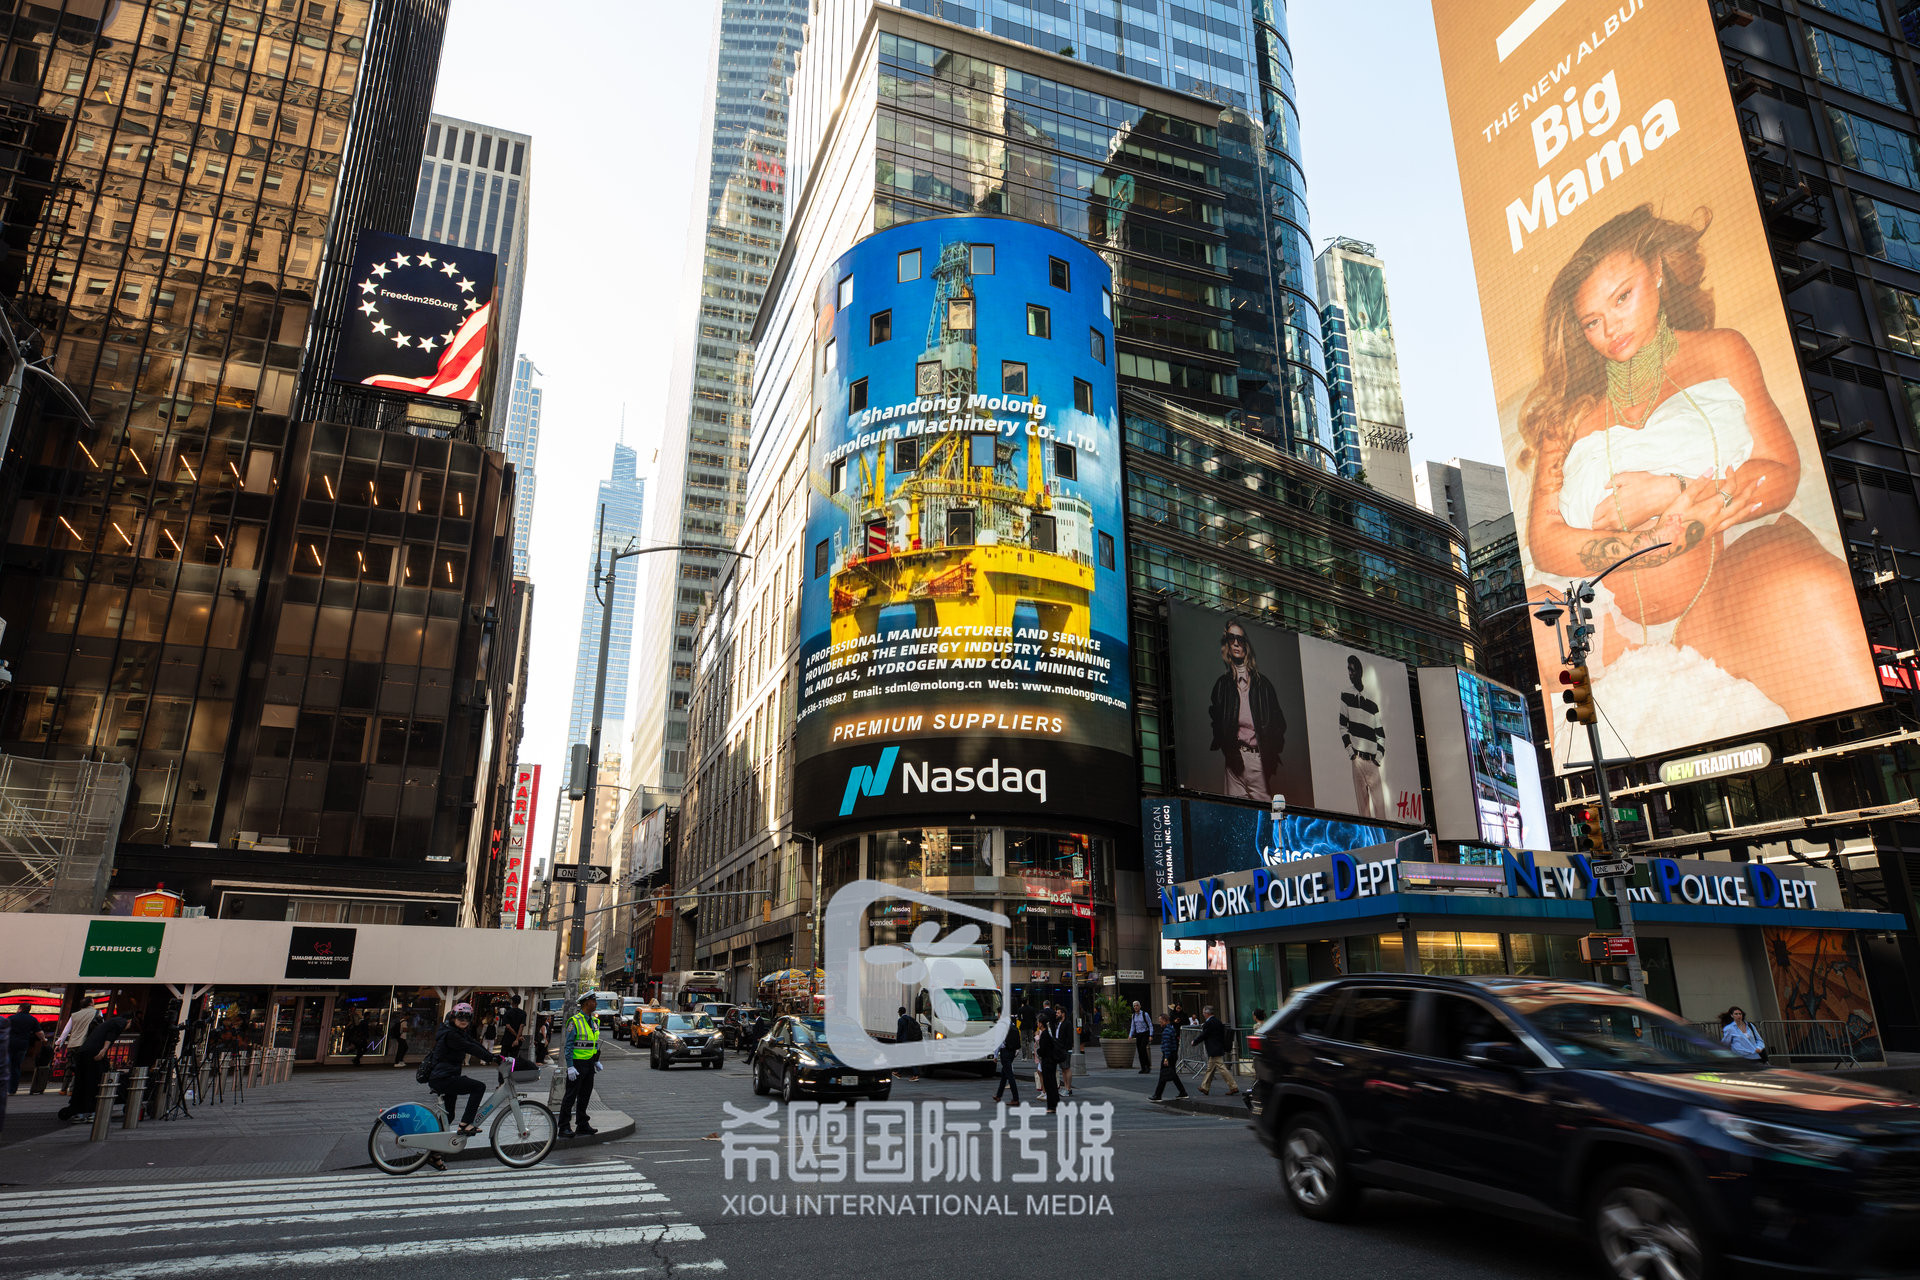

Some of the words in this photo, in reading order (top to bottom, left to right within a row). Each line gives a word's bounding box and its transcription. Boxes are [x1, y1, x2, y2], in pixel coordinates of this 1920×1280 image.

[1482, 102, 1521, 143] THE
[1522, 54, 1571, 111] NEW
[1531, 69, 1621, 169] Big
[1505, 98, 1681, 255] Mama
[380, 289, 459, 311] Freedom250.org
[861, 396, 962, 428] Shandong
[966, 394, 1047, 420] Molong
[822, 425, 901, 469] Petroleum
[905, 413, 1020, 438] Machinery
[1066, 430, 1100, 456] LTD.
[805, 657, 810, 669] A
[810, 633, 884, 666] PROFESSIONAL
[887, 625, 1013, 642] MANUFACTURER
[1016, 627, 1049, 640] AND
[1052, 631, 1101, 651] SERVICE
[805, 658, 843, 684] PROVIDER
[845, 652, 869, 667] FOR
[872, 645, 898, 661] THE
[900, 641, 961, 657] ENERGY
[964, 641, 1046, 659] INDUSTRY,
[1049, 647, 1111, 670] SPANNING
[804, 685, 814, 698] OIL
[814, 676, 834, 693] AND
[835, 668, 861, 684] GAS,
[866, 657, 948, 677] HYDROGEN
[951, 657, 987, 670] AND
[991, 658, 1031, 671] COAL
[1034, 660, 1085, 679] MINING
[1087, 669, 1109, 685] ETC.
[852, 686, 883, 700] Email:
[884, 679, 982, 694] sdml@molong.cn
[987, 679, 1019, 690] Web:
[1021, 682, 1127, 710] www.molonggroup.com
[832, 715, 924, 743] PREMIUM
[932, 713, 1063, 733] SUPPLIERS
[902, 758, 1047, 804] Nasdaq
[1666, 747, 1764, 782] NEWTRADITION
[513, 772, 531, 825] PARK
[1163, 805, 1171, 826] (IGC)
[1396, 790, 1422, 823] H&M
[1153, 806, 1165, 867] AMERICAN
[1165, 827, 1173, 844] INC.
[504, 858, 521, 912] PARK
[1501, 848, 1577, 899] NEW
[1653, 858, 1750, 907] POLICE
[1749, 863, 1818, 909] DEPT
[1595, 865, 1608, 873] ONE
[1614, 863, 1628, 871] WAY
[1161, 885, 1199, 924] NEW
[1199, 878, 1251, 918] YORK
[1253, 868, 1326, 911] POLICE
[1331, 853, 1398, 900] DEPT
[891, 905, 911, 914] Nasdaq
[1026, 905, 1047, 914] Nasdaq
[89, 945, 142, 953] STARBUCKS
[386, 1112, 397, 1120] citi
